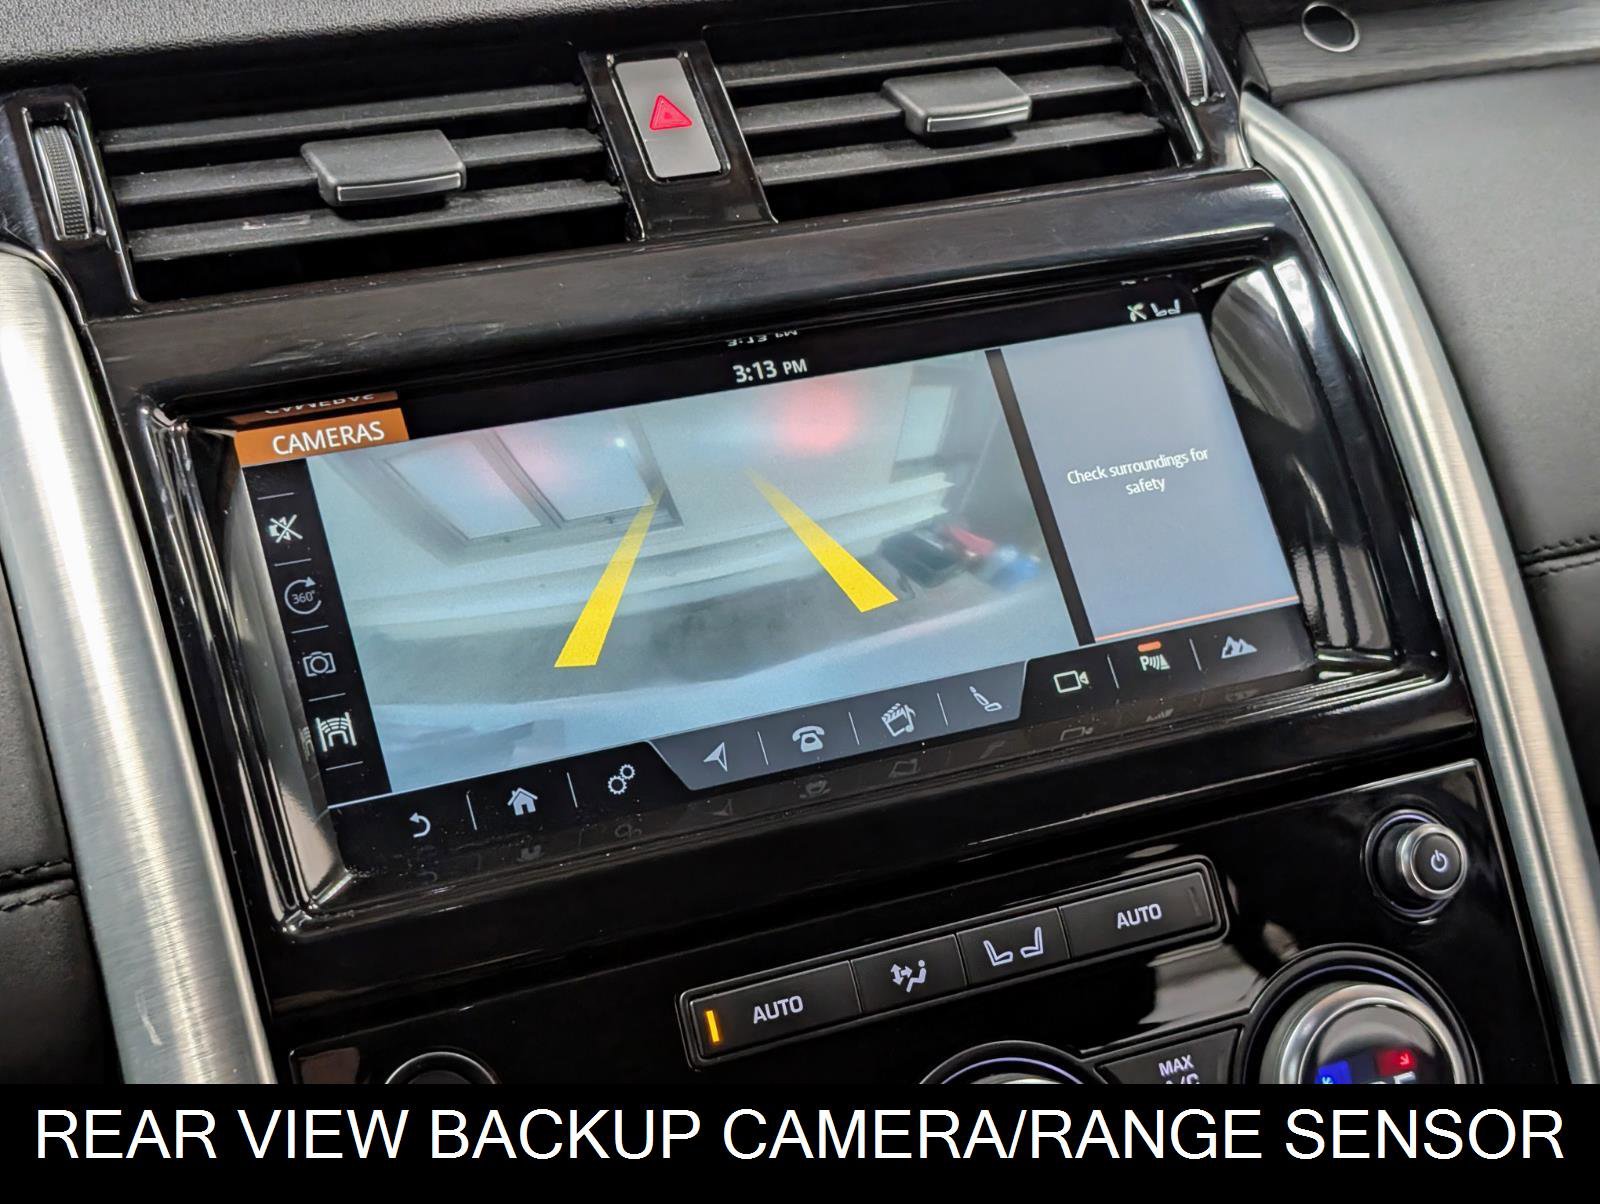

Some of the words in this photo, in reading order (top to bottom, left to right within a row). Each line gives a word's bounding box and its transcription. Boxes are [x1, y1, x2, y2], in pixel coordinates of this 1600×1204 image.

[732, 359, 778, 384] 3:13
[782, 357, 808, 376] PM
[271, 420, 386, 456] CAMERAS
[1066, 465, 1109, 485] Check
[1109, 452, 1190, 478] surroundings
[1189, 447, 1209, 462] for
[1125, 477, 1167, 496] safety
[1116, 903, 1163, 930] AUTO
[752, 995, 804, 1025] AUTO
[1158, 1054, 1195, 1078] MAX
